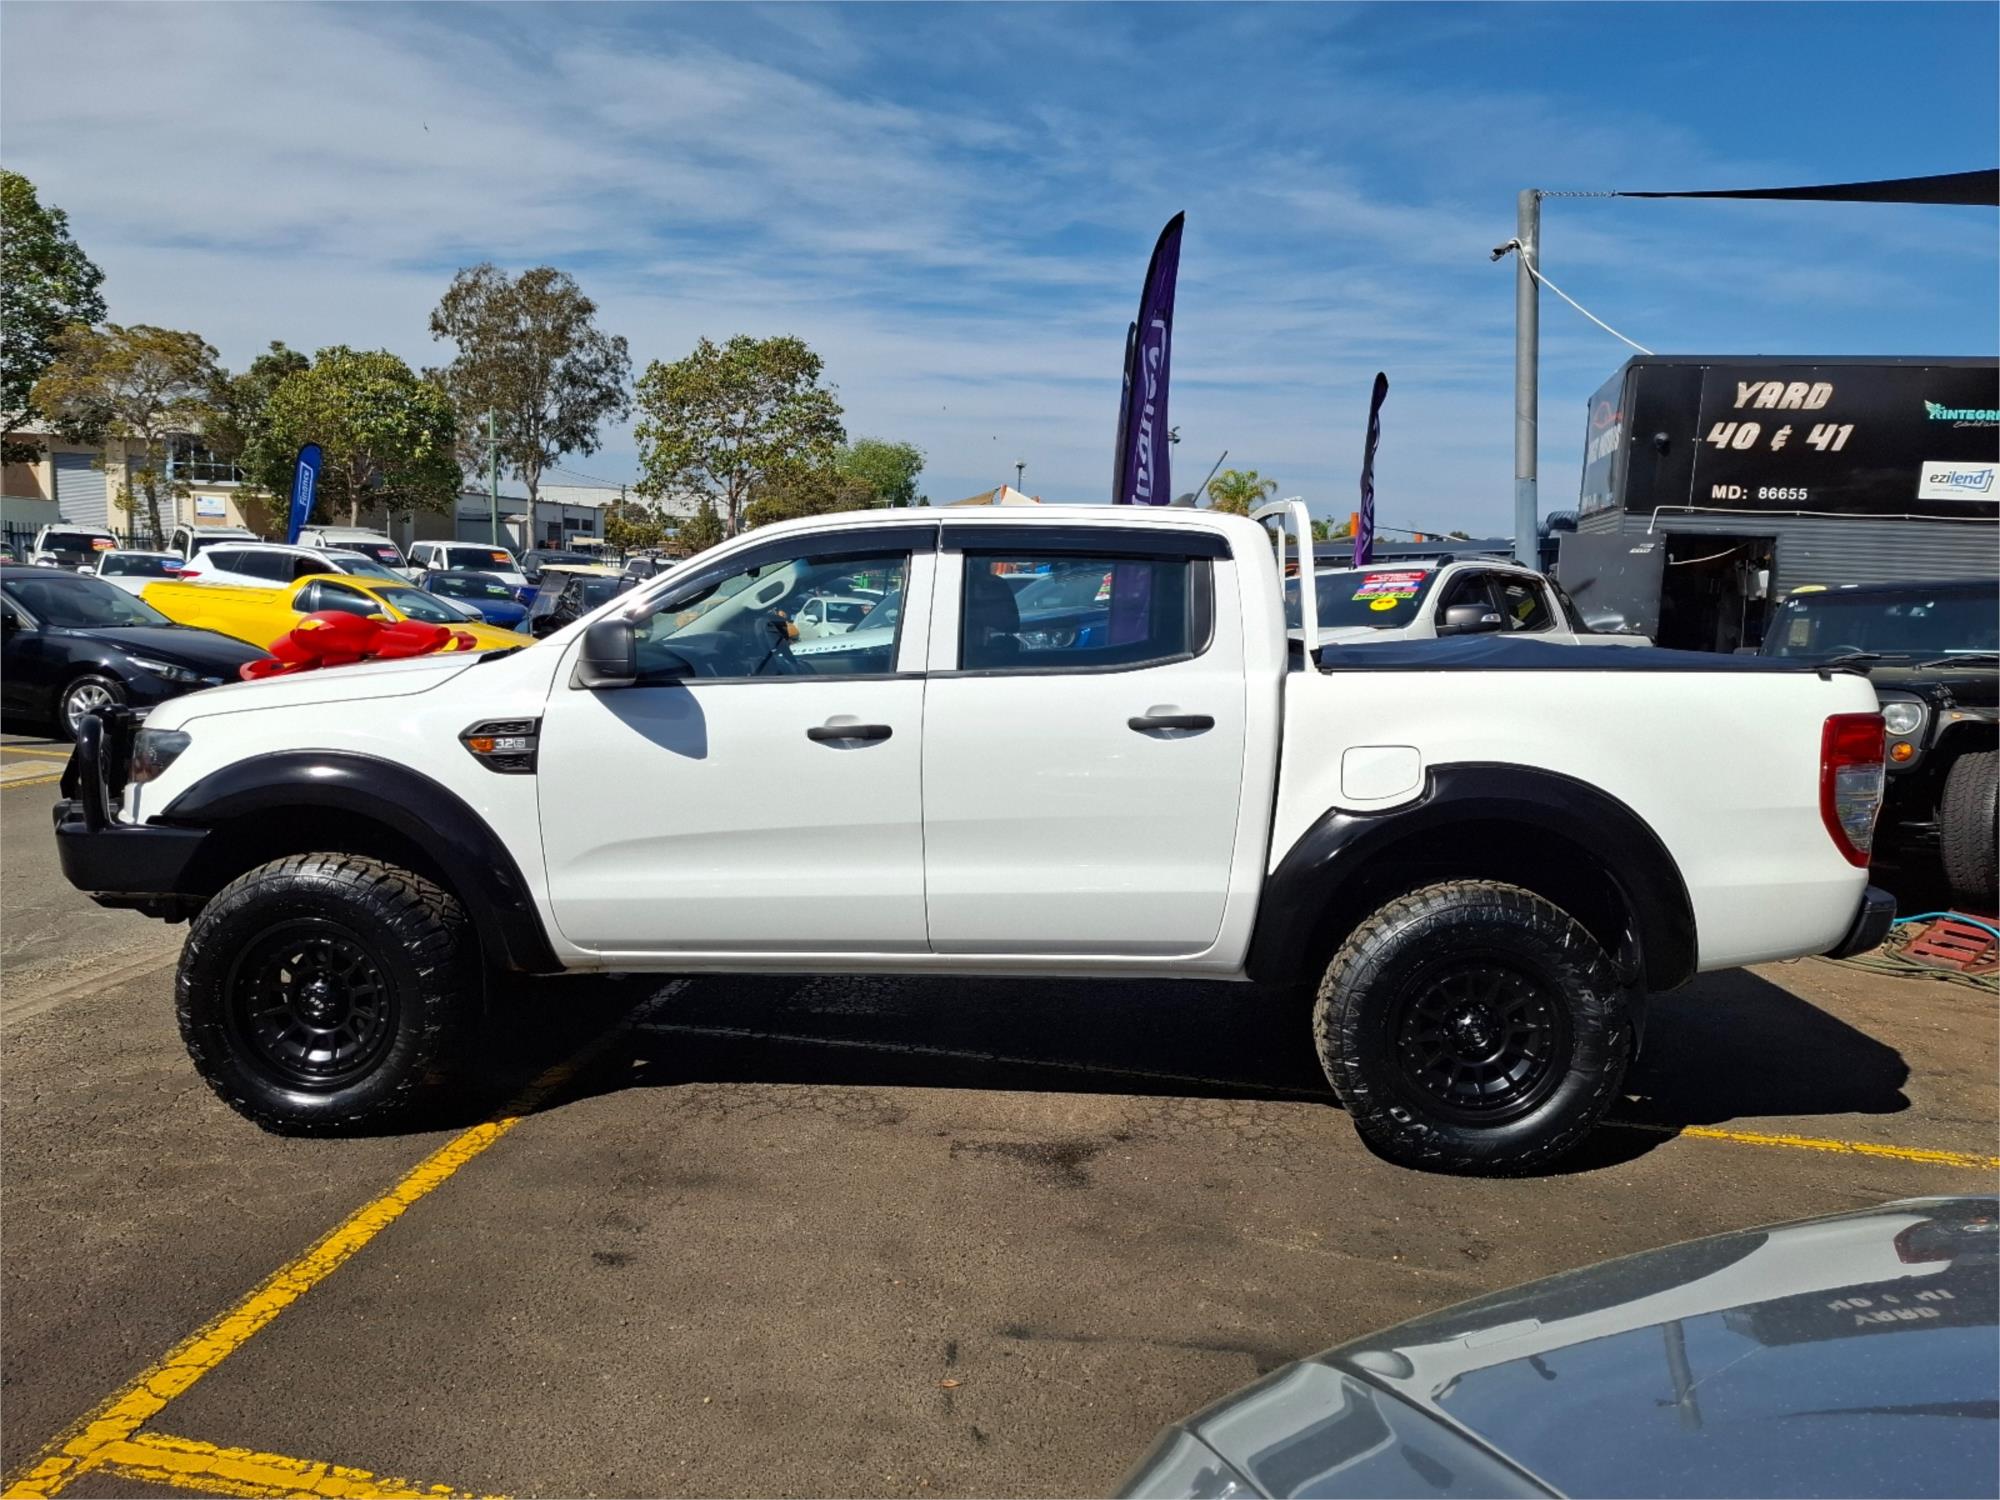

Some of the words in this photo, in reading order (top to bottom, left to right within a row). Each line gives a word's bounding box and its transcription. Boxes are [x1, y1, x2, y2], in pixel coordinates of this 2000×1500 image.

[1733, 381, 1834, 410] YARD
[1706, 421, 1761, 450] 40
[1806, 423, 1855, 452] 41
[300, 470, 310, 506] Finance
[1711, 484, 1748, 500] MD:
[1758, 486, 1808, 501] 86655
[1929, 471, 1985, 485] ezilend
